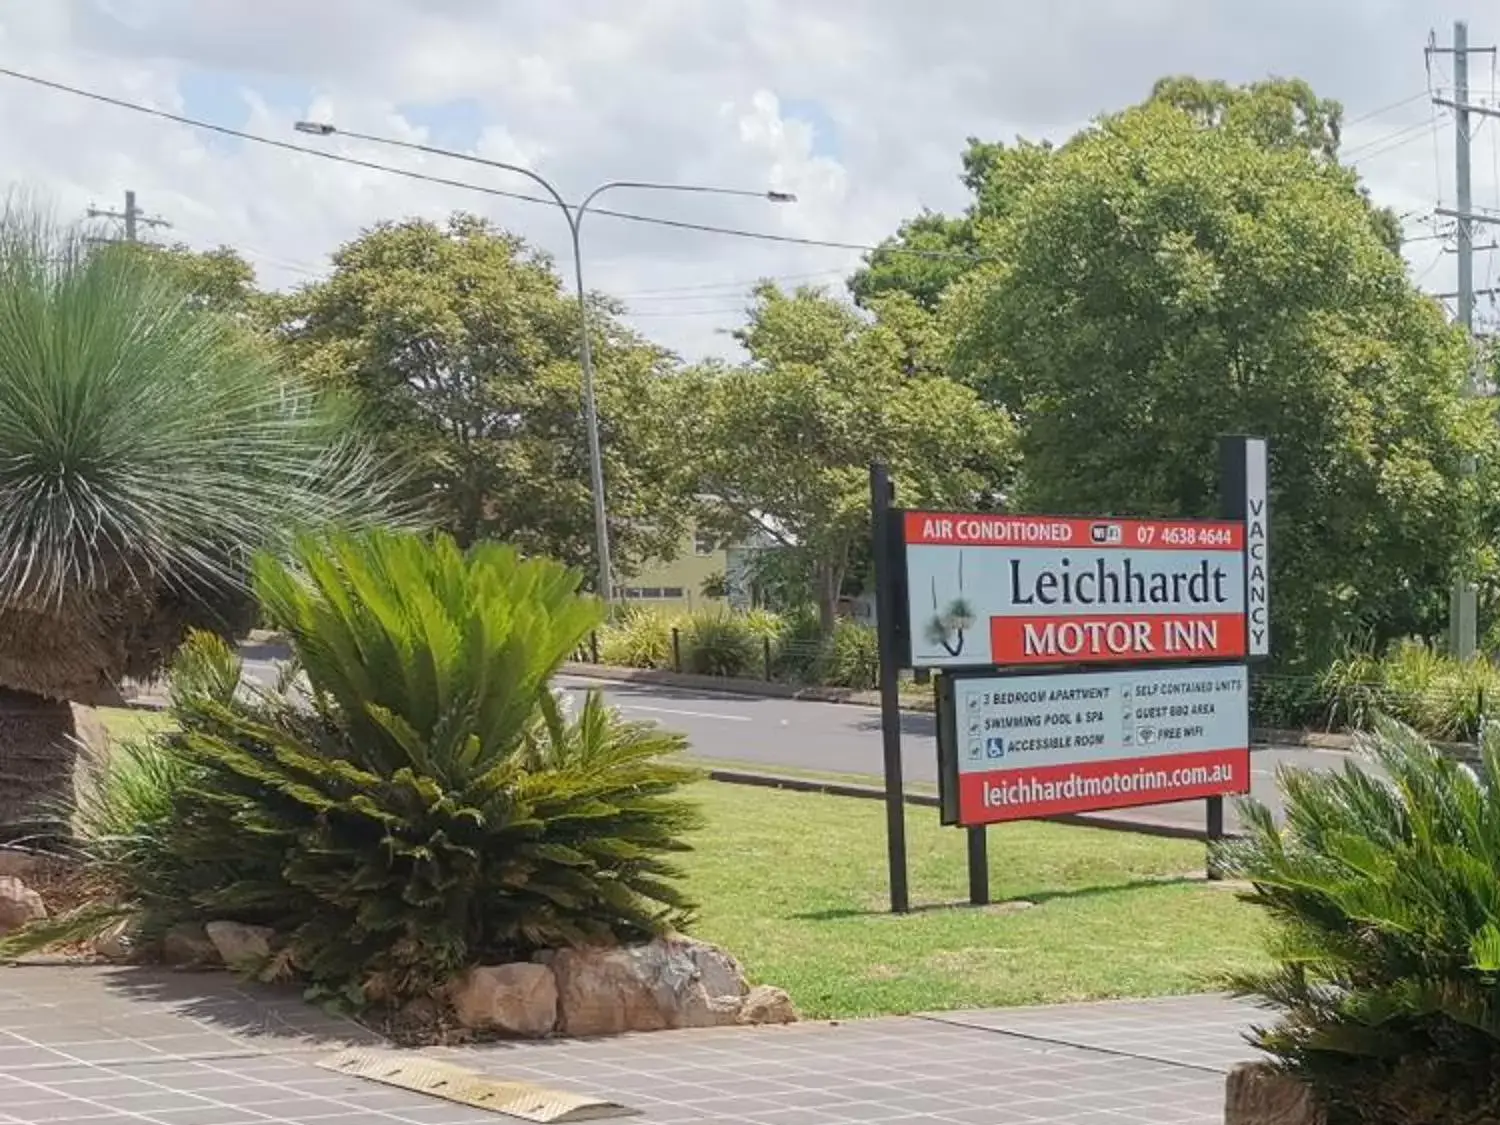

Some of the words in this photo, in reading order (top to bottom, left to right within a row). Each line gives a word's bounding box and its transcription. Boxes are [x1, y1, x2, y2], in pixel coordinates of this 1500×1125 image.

[923, 519, 953, 539] AIR
[956, 520, 1073, 541] CONDITIONED
[1137, 525, 1155, 543] 07
[1161, 527, 1197, 544] 4638
[1198, 529, 1232, 545] 4644
[1009, 557, 1228, 604] Leichhardt
[1249, 499, 1265, 646] VACANCY
[1023, 620, 1156, 656] MOTOR
[1162, 619, 1218, 652] INN
[993, 689, 1047, 705] BEDROOM
[1049, 687, 1110, 701] APARTMENT
[984, 715, 1041, 730] SWIMMING
[1043, 713, 1072, 726] POOL
[1007, 735, 1072, 753] ACCESSIBLE
[1074, 733, 1105, 748] ROOM
[983, 763, 1233, 807] leichhardtmotorinn.com.au
